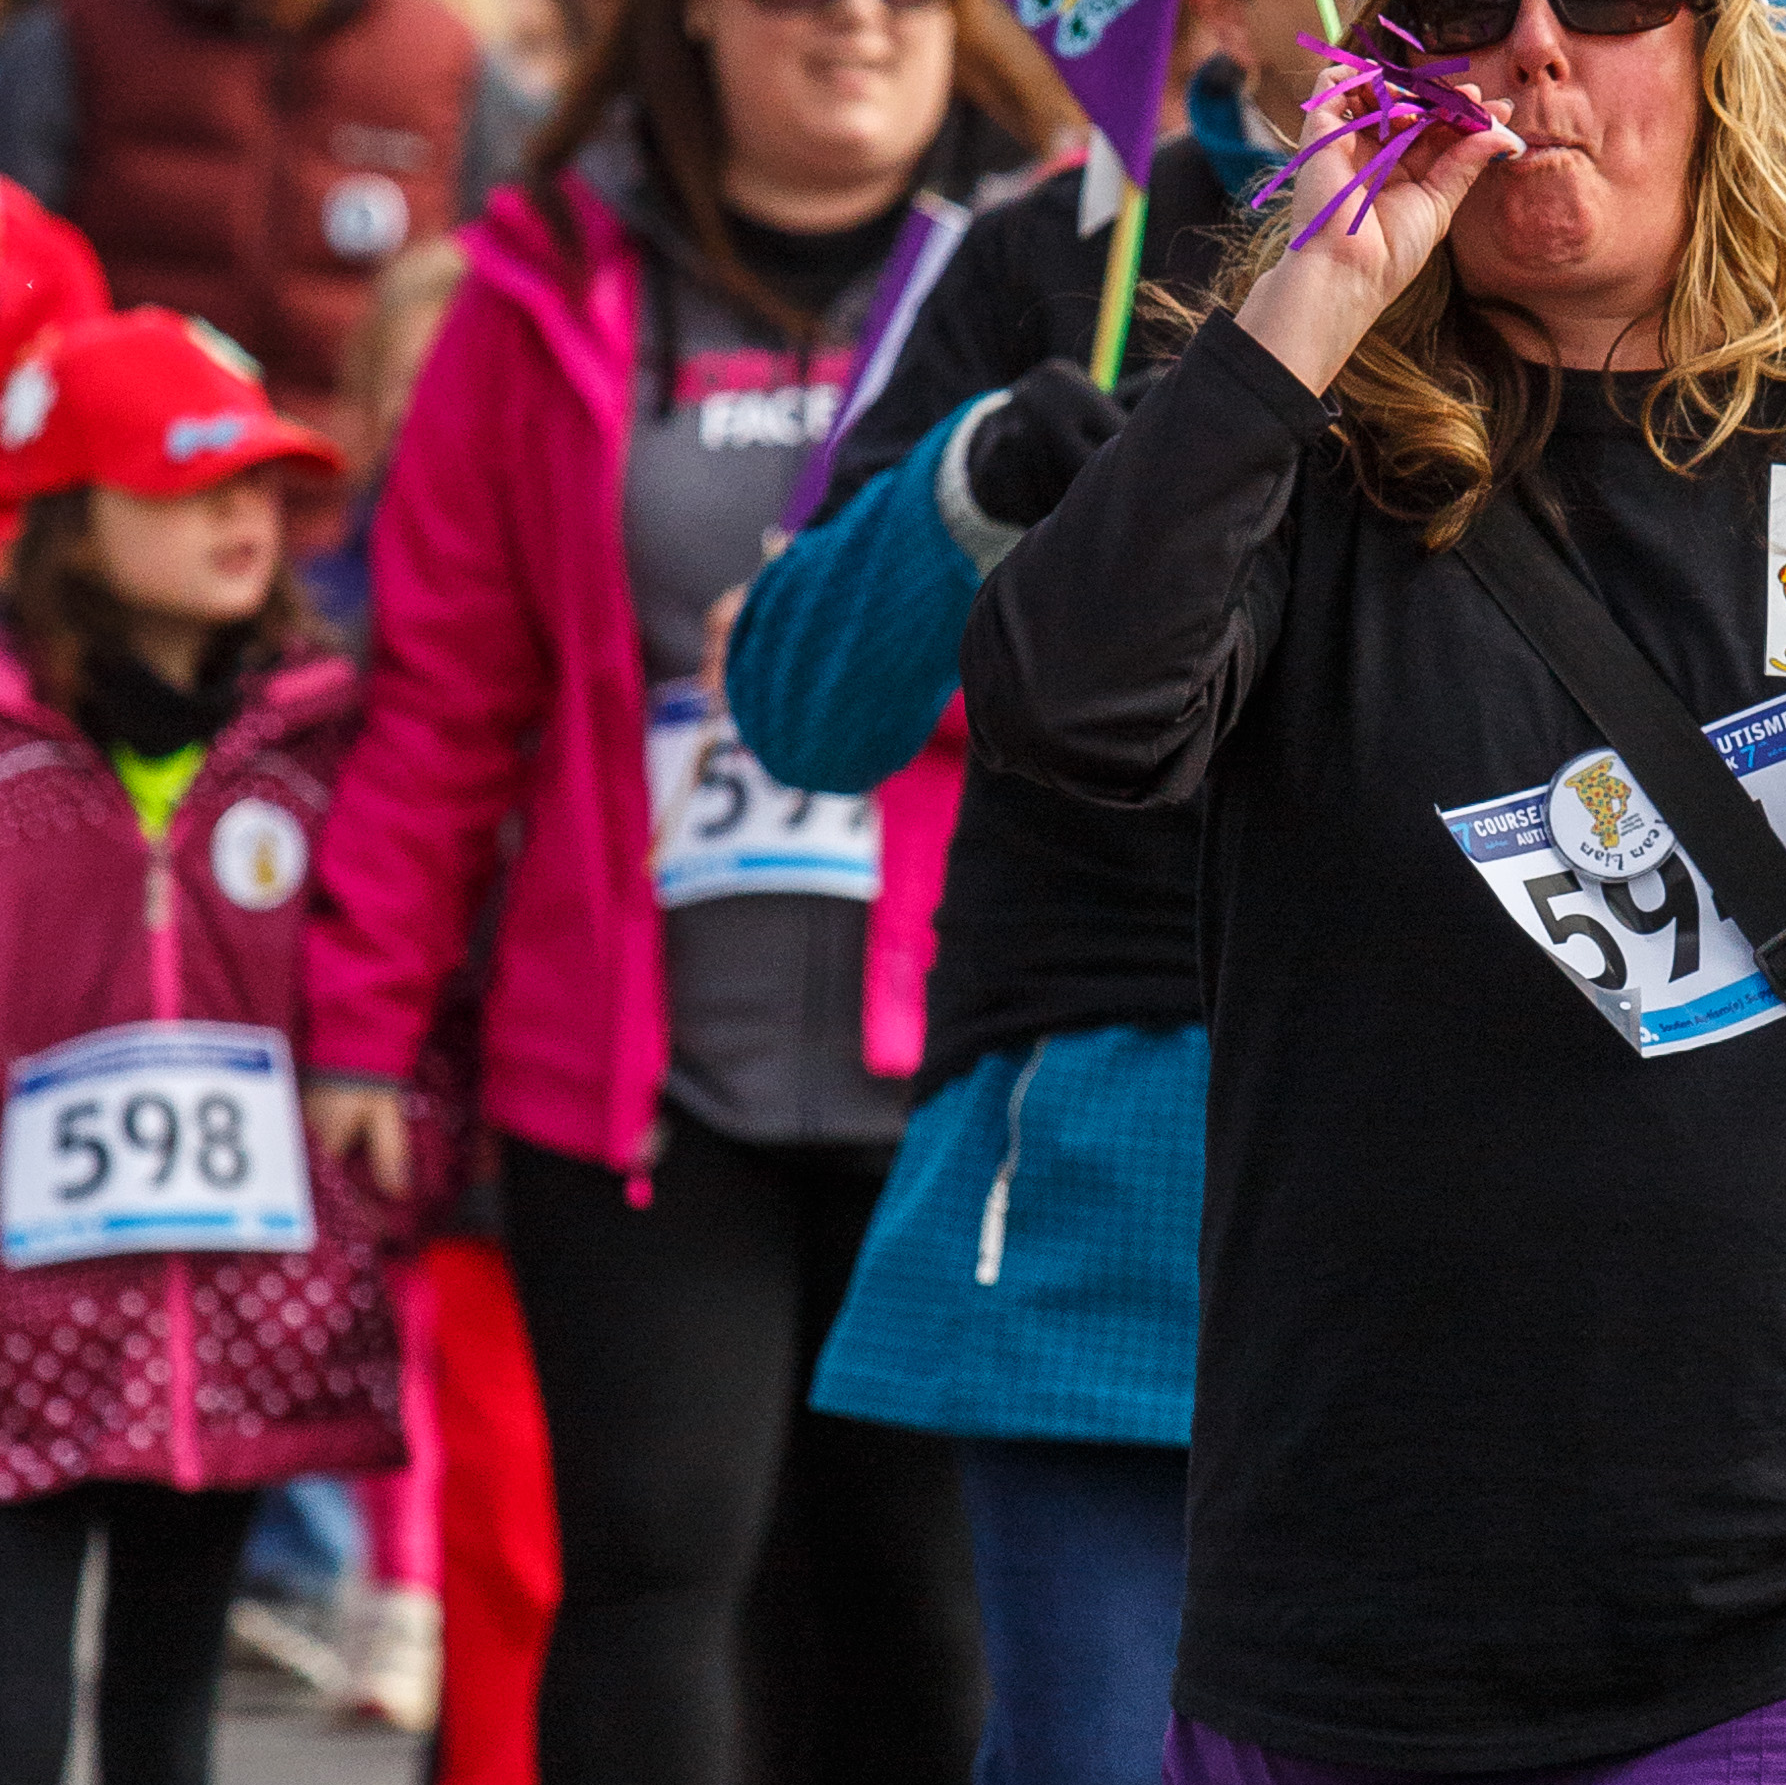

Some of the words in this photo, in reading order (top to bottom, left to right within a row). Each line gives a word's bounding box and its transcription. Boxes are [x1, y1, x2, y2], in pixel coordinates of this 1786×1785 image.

[1516, 828, 1547, 846] AUTI
[1630, 819, 1663, 858] eam
[1523, 851, 1701, 990] 59
[55, 1090, 251, 1201] 598
